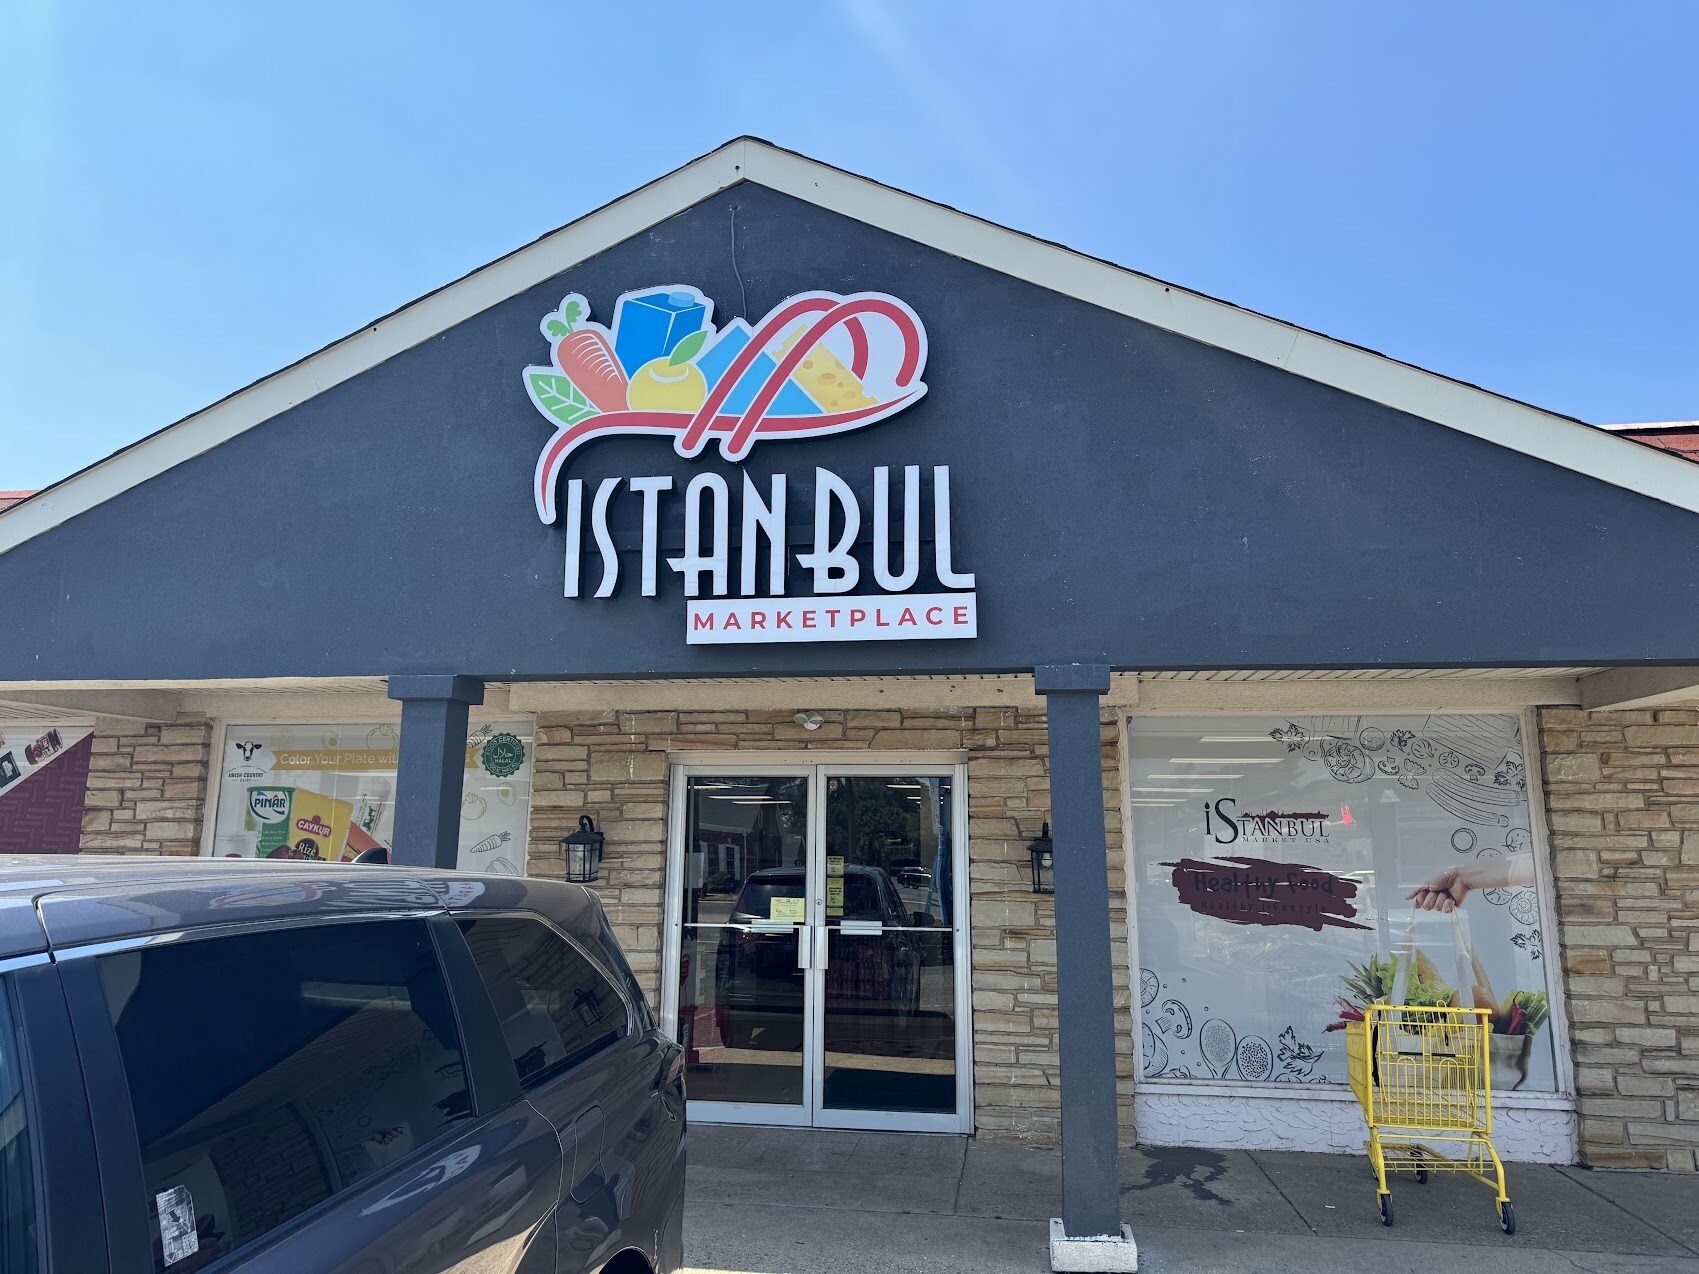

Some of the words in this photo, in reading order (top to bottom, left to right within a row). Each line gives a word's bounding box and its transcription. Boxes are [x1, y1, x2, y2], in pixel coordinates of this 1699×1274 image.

[563, 465, 976, 598] ISTANBUL
[692, 605, 969, 632] MARKETPLACE
[280, 753, 312, 765] Color
[315, 753, 341, 765] Your
[343, 753, 375, 765] Plate
[1242, 836, 1297, 844] MARKET
[298, 842, 317, 856] Rize
[1194, 871, 1279, 898] Healthy
[1201, 901, 1254, 912] Healthy
